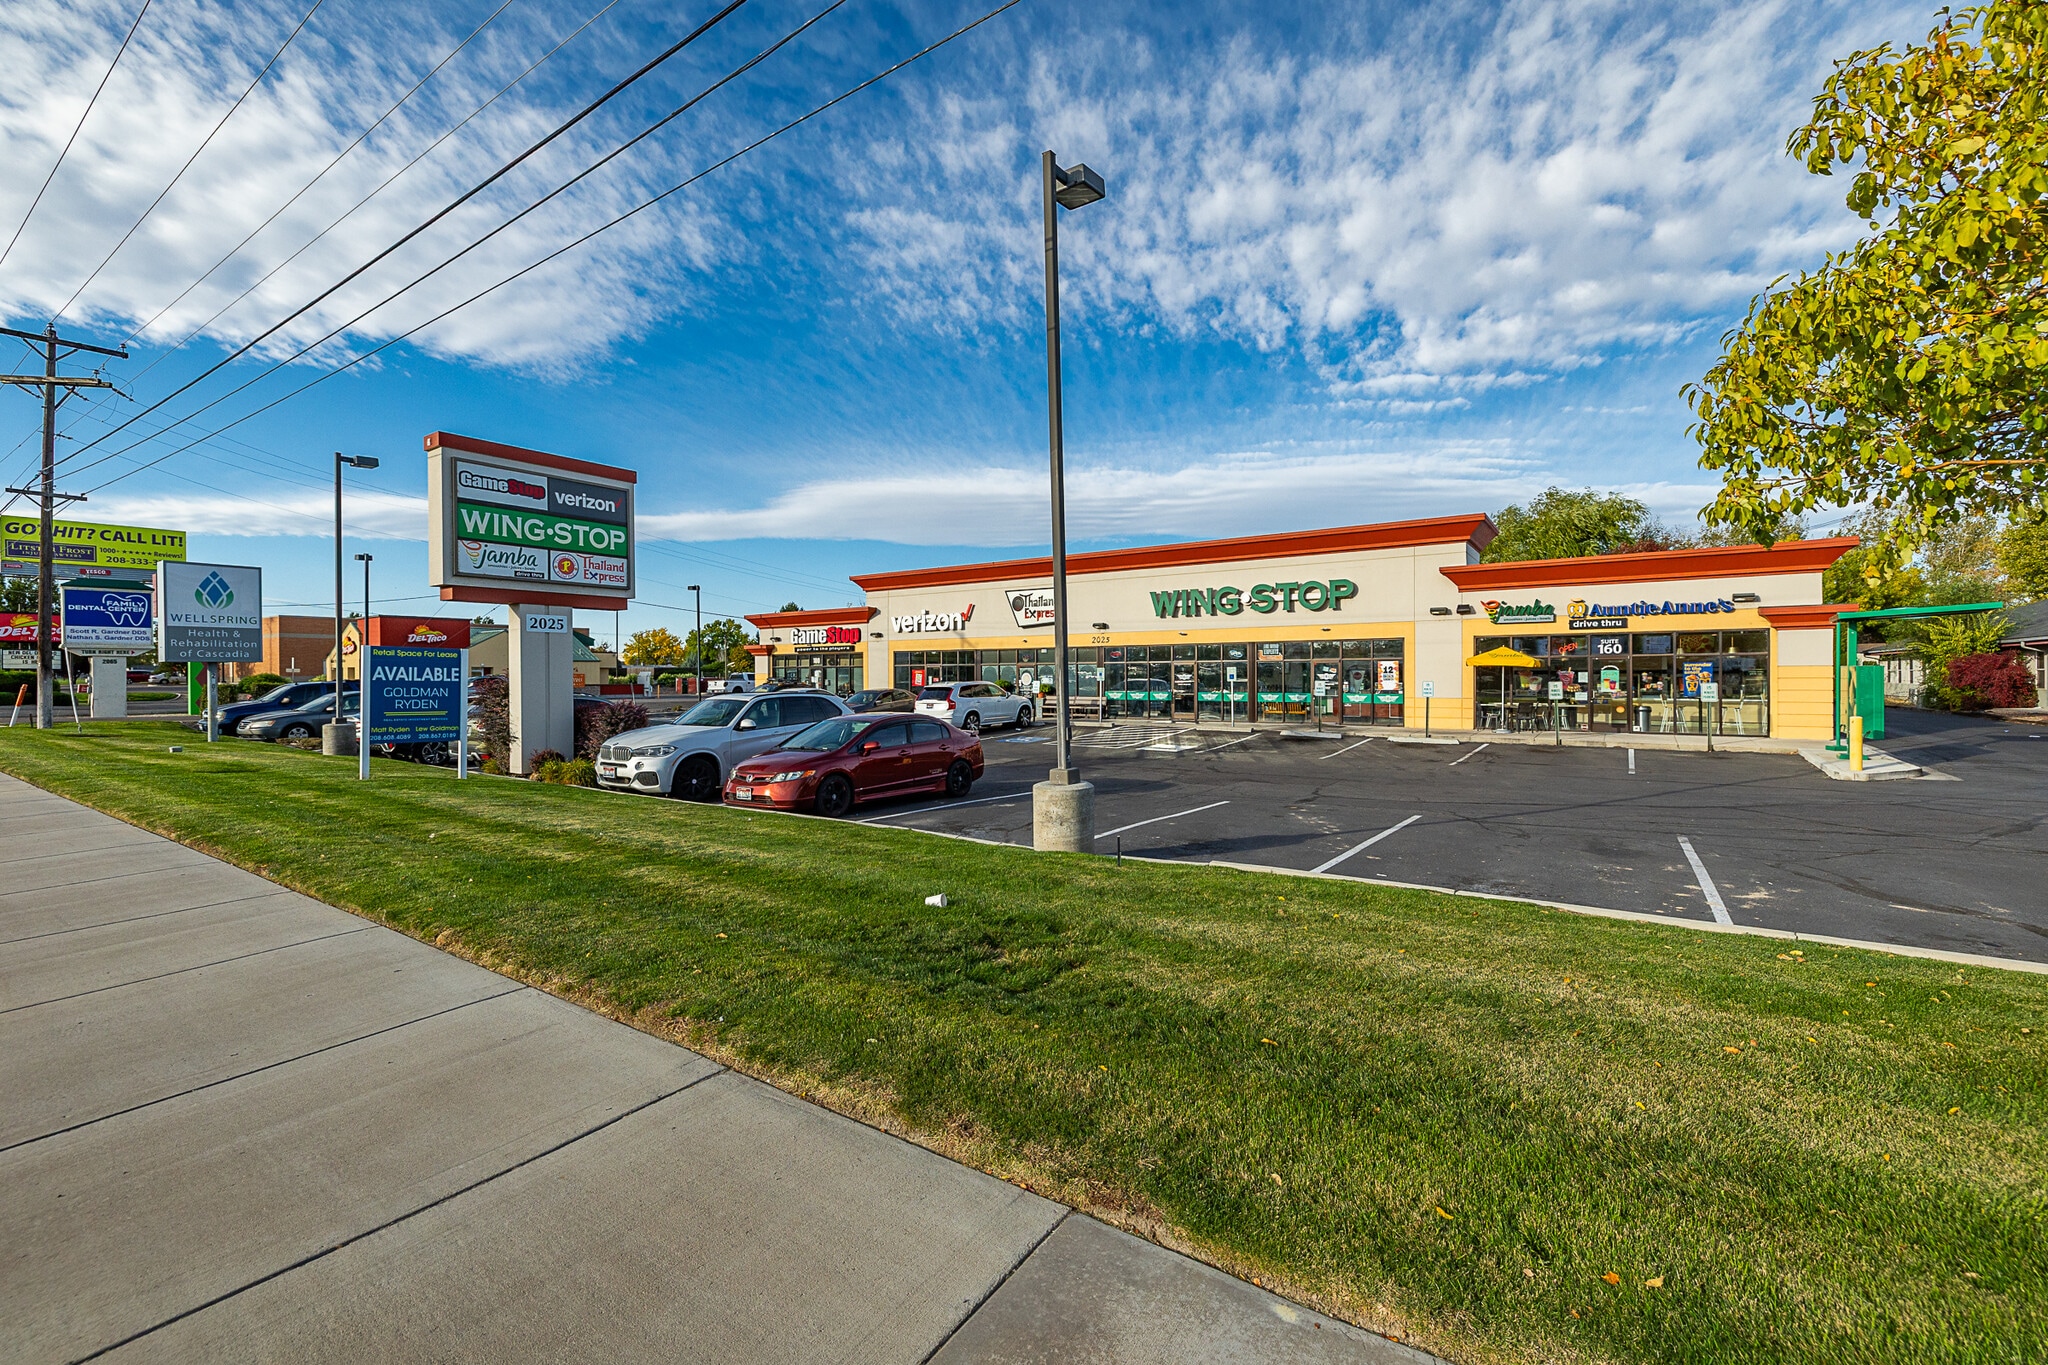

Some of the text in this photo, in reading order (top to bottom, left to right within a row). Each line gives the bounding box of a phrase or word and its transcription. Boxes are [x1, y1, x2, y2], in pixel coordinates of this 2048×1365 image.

[459, 470, 546, 500] GameStop
[555, 491, 616, 513] verizon
[5, 522, 183, 547] GO HIT? CALL LIT!
[153, 551, 183, 559] Reviews!
[473, 544, 538, 569] jamba
[577, 553, 625, 572] Thailand
[583, 569, 625, 583] Express
[1019, 593, 1055, 607] Thailan
[1024, 608, 1055, 622] Expres
[1490, 599, 1555, 624] jamba
[170, 613, 258, 625] WELLSPRING
[529, 617, 564, 630] 2025
[891, 609, 964, 633] verizon
[1572, 619, 1622, 628] drive thru
[188, 629, 241, 638] Health &
[407, 634, 447, 643] DEL TACO
[790, 626, 861, 645] GameStop
[170, 639, 257, 648] Rehabilitation
[1559, 642, 1578, 654] OPEN
[1597, 644, 1623, 654] 160
[180, 650, 250, 658] of Cascadia
[372, 666, 460, 682] AVAILABLE
[1384, 666, 1394, 674] 12
[383, 687, 449, 698] GOLDMAN
[395, 699, 439, 709] RYDEN
[388, 726, 410, 734] Ryden
